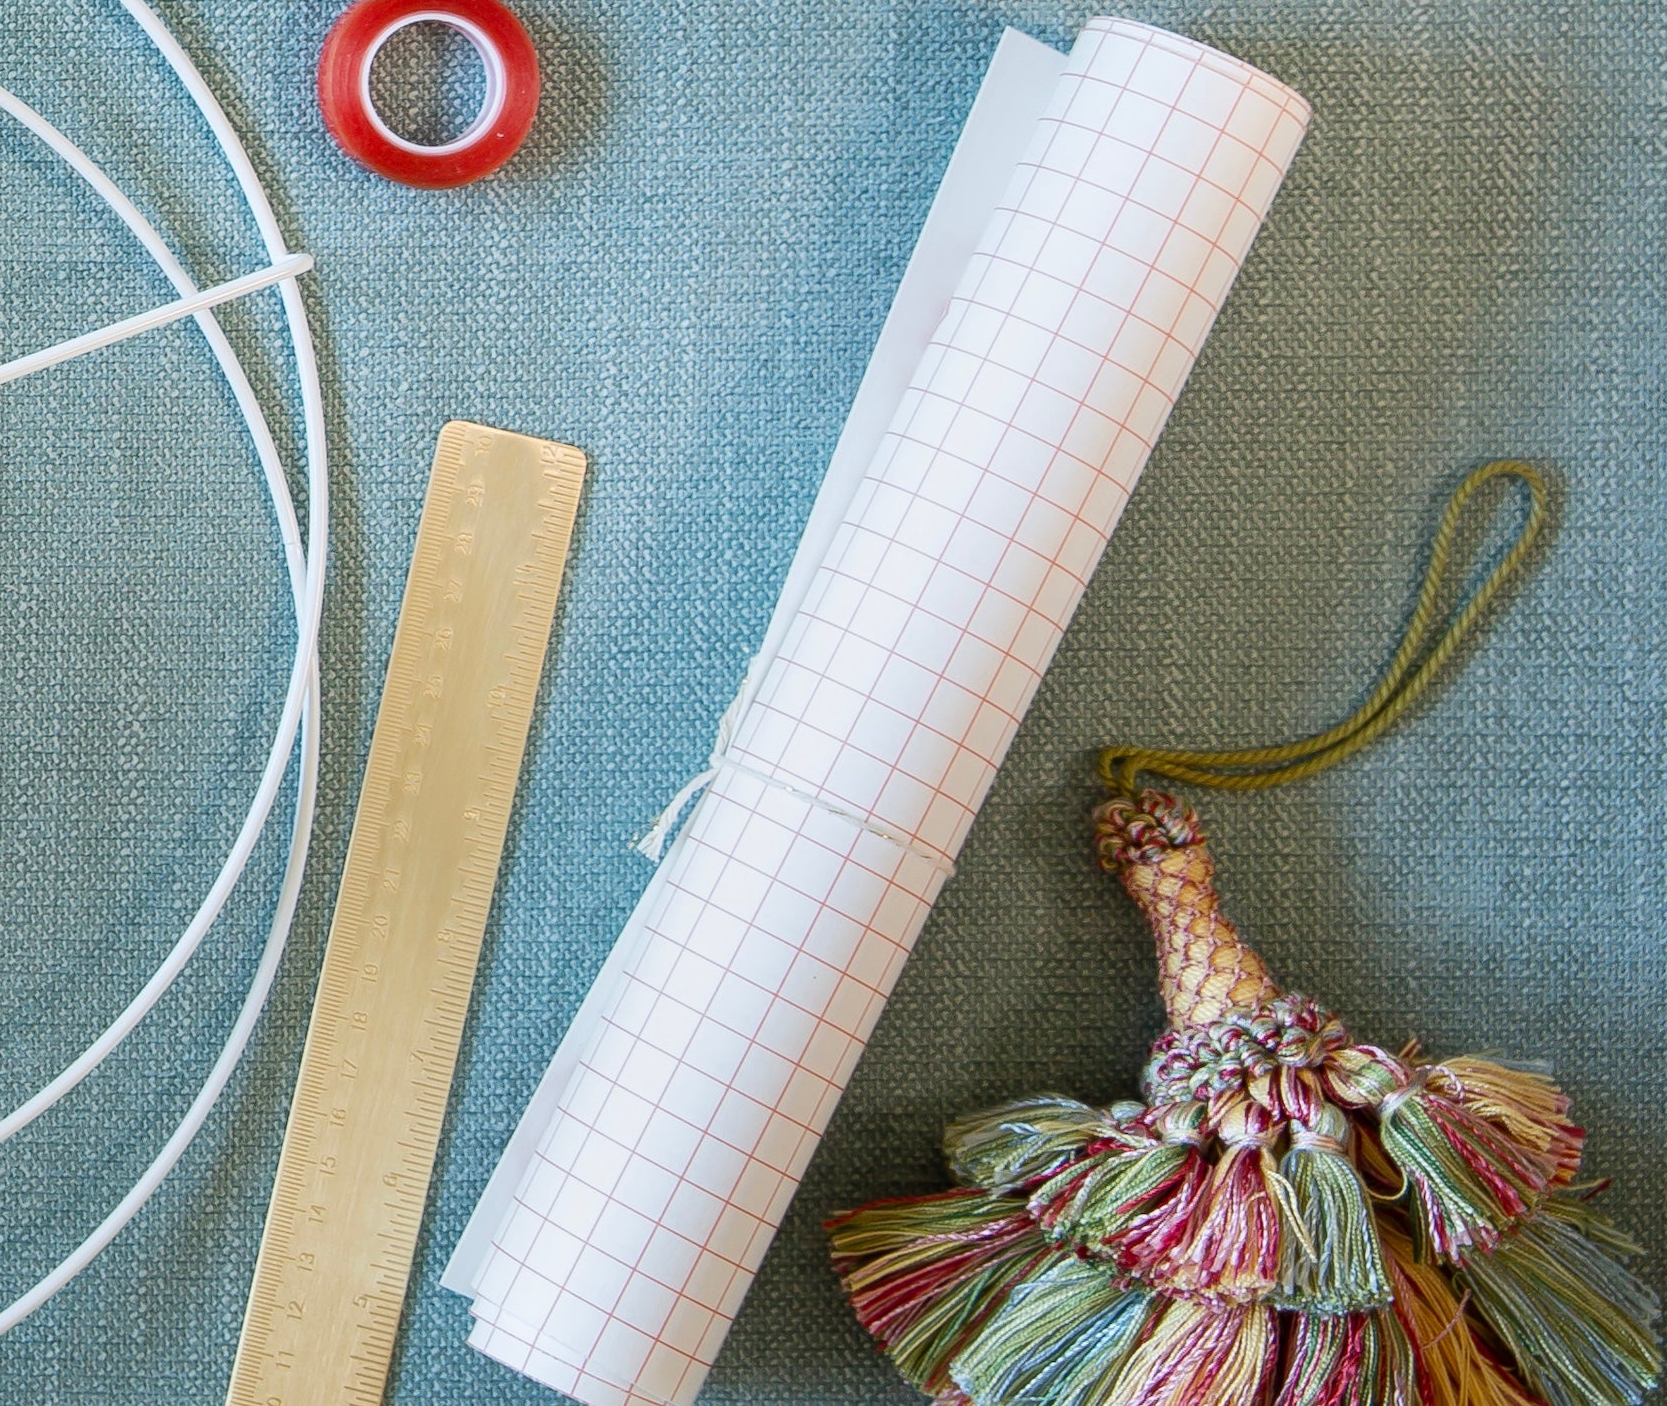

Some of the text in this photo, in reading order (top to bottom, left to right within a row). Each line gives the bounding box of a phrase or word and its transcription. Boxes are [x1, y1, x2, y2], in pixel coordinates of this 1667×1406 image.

[275, 1350, 295, 1369] 11
[287, 1299, 306, 1321] 12
[298, 1252, 316, 1274] 13
[309, 1204, 327, 1226] 14
[319, 1156, 337, 1178] 15
[329, 1107, 348, 1129] 16
[340, 1058, 359, 1082] 17
[351, 1012, 369, 1034] 18
[361, 962, 380, 985] 19
[371, 915, 391, 939] 20
[353, 1295, 368, 1308] 5
[383, 1174, 398, 1188] 6
[409, 1050, 425, 1063] 7
